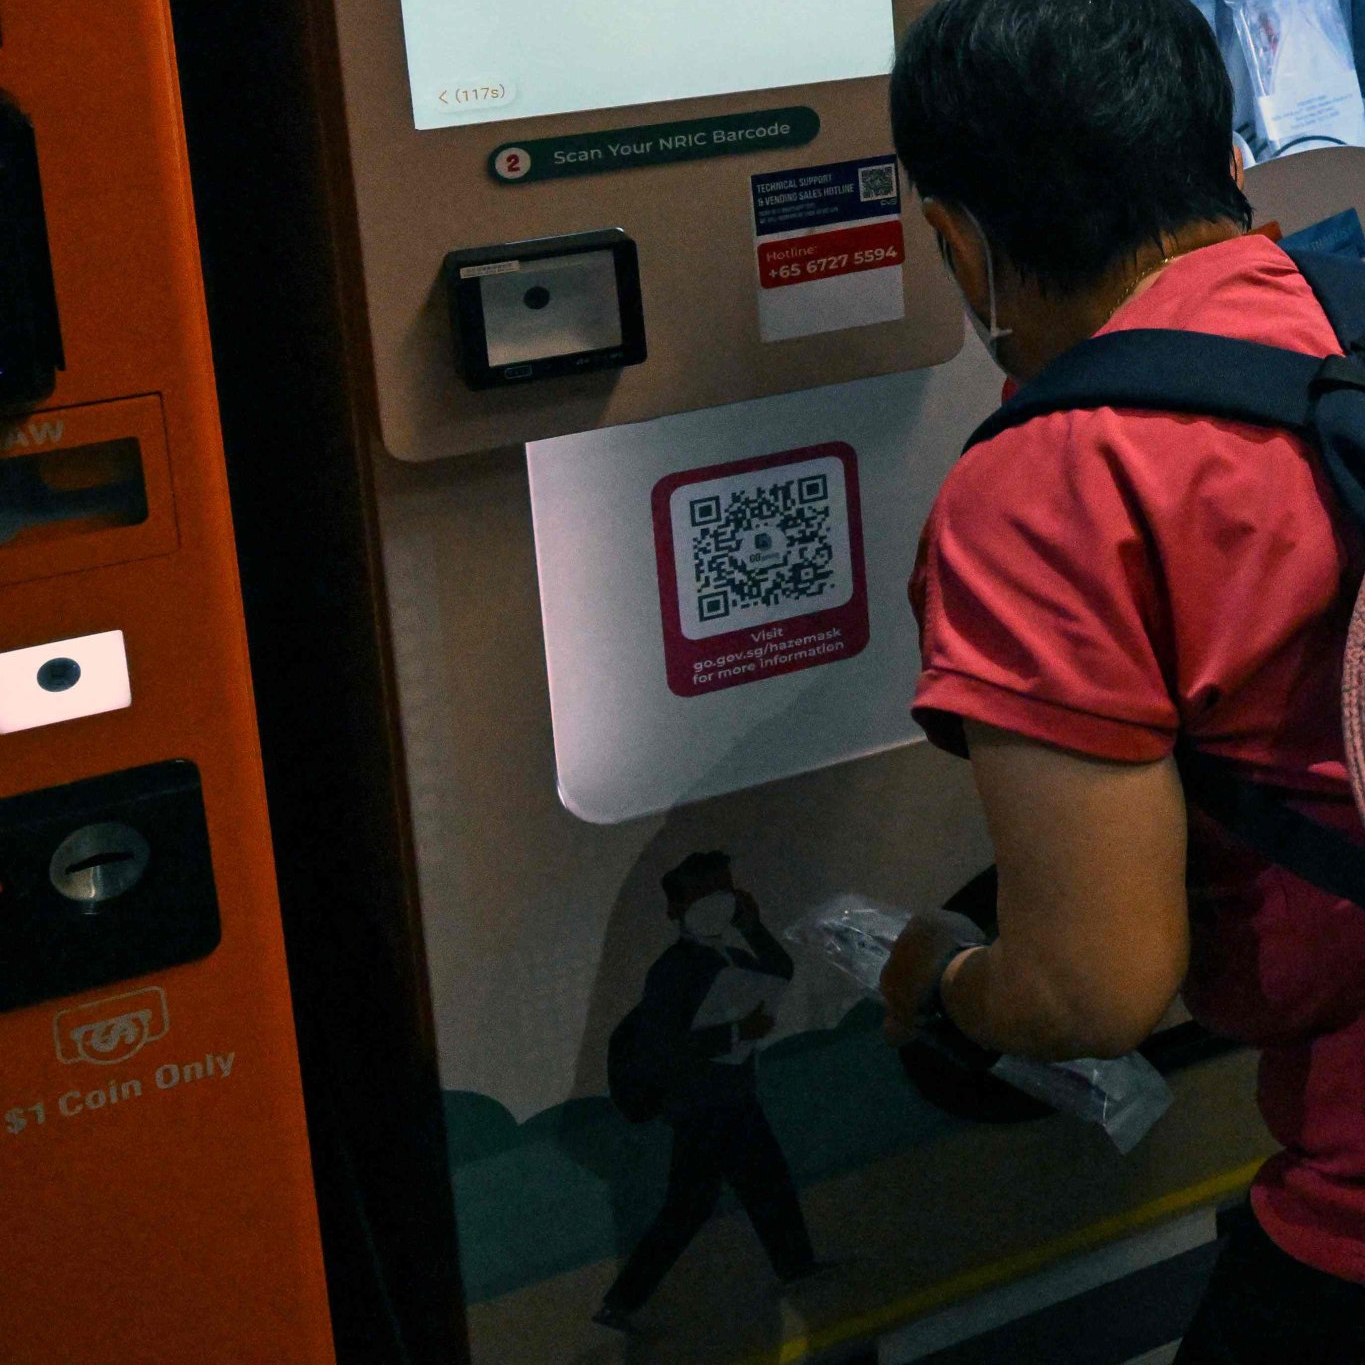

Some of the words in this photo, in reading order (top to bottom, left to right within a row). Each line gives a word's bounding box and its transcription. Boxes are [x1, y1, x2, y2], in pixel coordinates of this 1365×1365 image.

[455, 84, 505, 104] (117s)
[506, 154, 521, 173] 2
[554, 147, 602, 166] Scan
[608, 141, 653, 158] Your
[659, 132, 707, 151] NRIC
[713, 121, 791, 146] Barcode
[756, 179, 797, 194] TECHNICAL
[799, 174, 832, 187] SUPPORT
[765, 192, 797, 206] VENDING
[799, 188, 822, 201] SALES
[823, 183, 855, 198] HOTLINE
[768, 263, 801, 278] +65
[806, 254, 848, 274] 6727
[854, 245, 898, 264] 5594
[692, 627, 842, 673] go.gov.sg/hazemask
[751, 627, 783, 643] Visit
[692, 670, 714, 686] for
[717, 663, 756, 681] more
[760, 639, 844, 669] information
[4, 1102, 45, 1134] $1
[58, 1080, 142, 1116] Coin
[155, 1052, 236, 1090] Only
